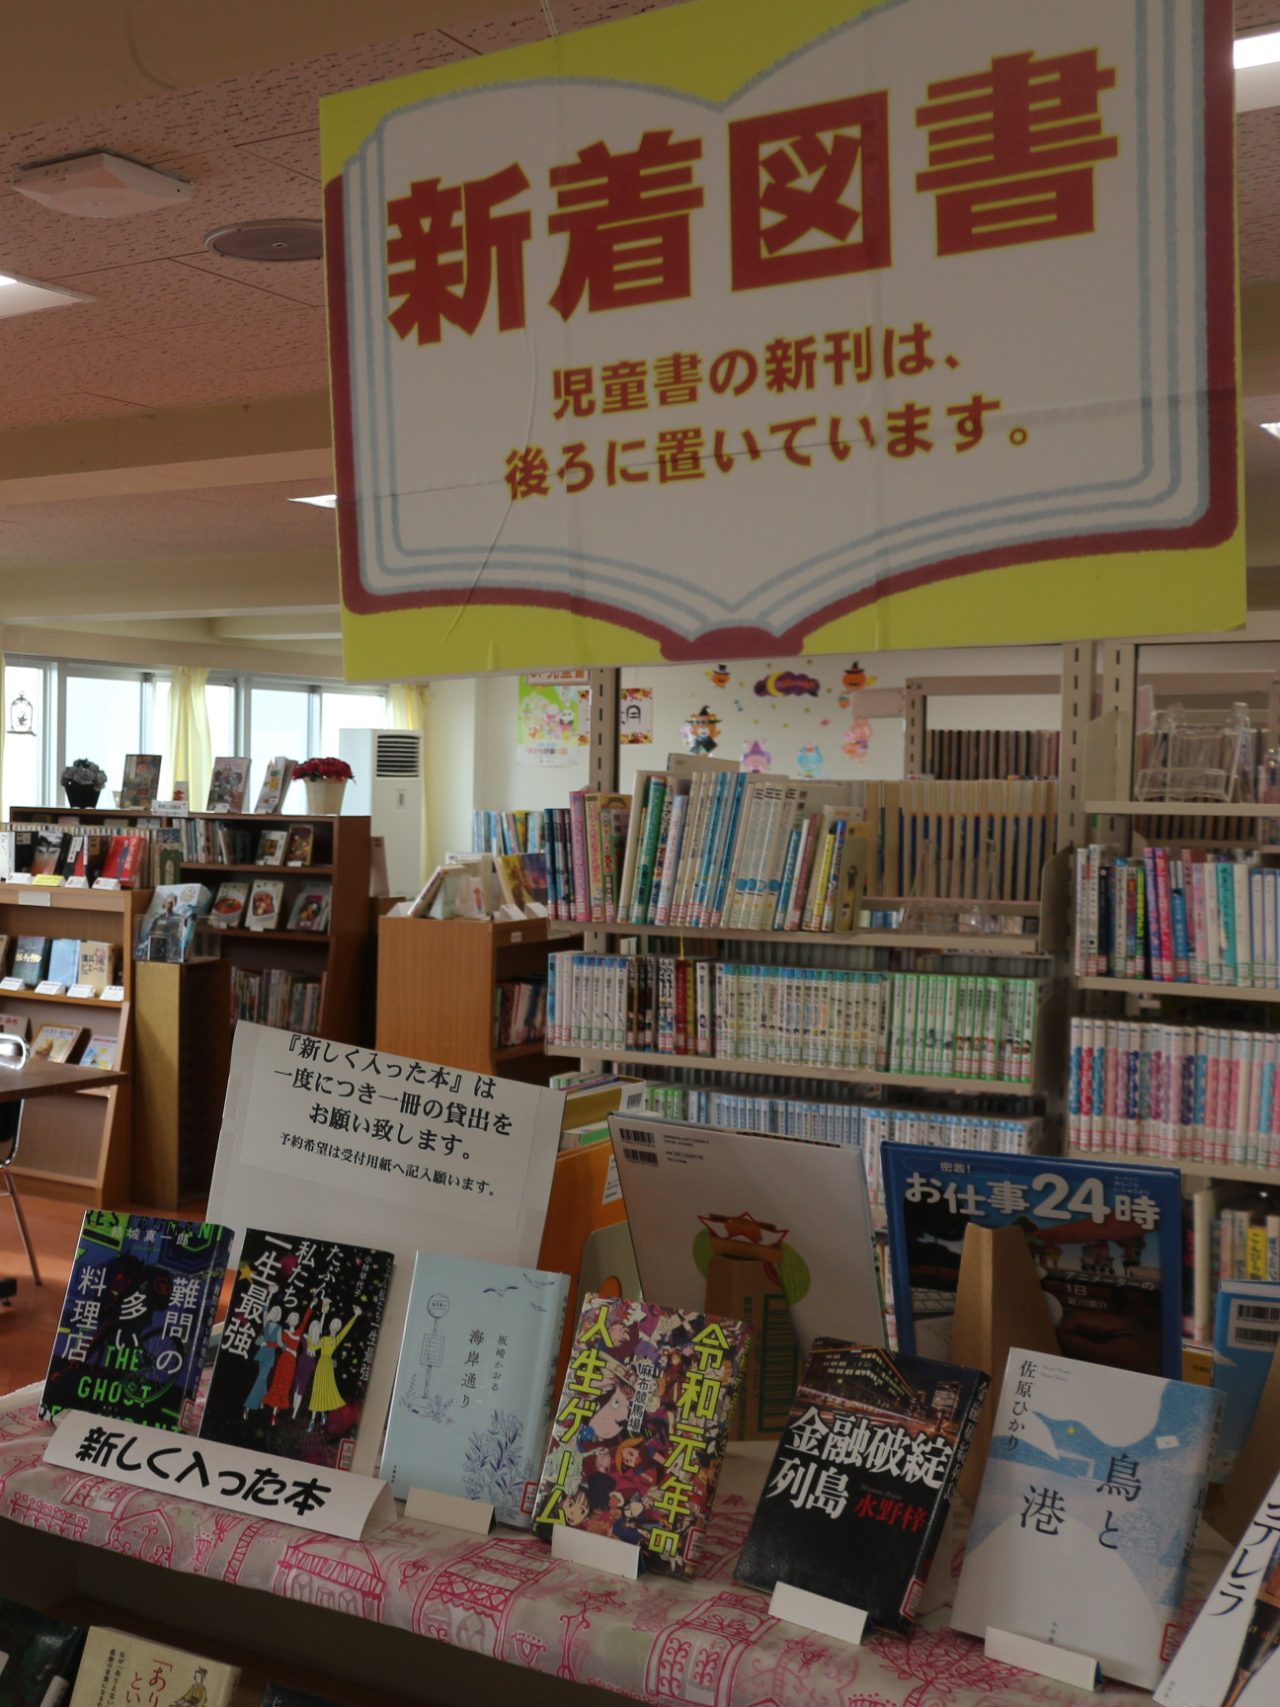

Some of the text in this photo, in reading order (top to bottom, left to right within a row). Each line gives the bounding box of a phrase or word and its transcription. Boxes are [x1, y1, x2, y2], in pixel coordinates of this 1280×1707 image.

[386, 48, 1118, 347] 新着図書
[551, 322, 960, 424] 児童書の新刊は、
[505, 394, 1029, 501] 後ろに置いています。
[274, 1068, 513, 1136] 一度につき一冊の貸出を
[289, 1034, 495, 1099] 『新しく入った本』は
[280, 1132, 495, 1196] 予約希望は受付用紙へ記入願います。
[309, 1103, 471, 1160] お願い致します。
[905, 1172, 1161, 1232] お仕事24時
[221, 1235, 292, 1360] 一生最強
[283, 1241, 317, 1308] 私たち
[318, 1246, 344, 1300] たぶん
[61, 1265, 107, 1363] 料理店
[115, 1291, 148, 1348] 多い
[155, 1277, 200, 1374] 難問の
[77, 1376, 151, 1408] GHOST
[104, 1344, 144, 1372] THE
[461, 1329, 485, 1408] 海岸通り
[537, 1305, 613, 1527] 人生ゲーム
[649, 1322, 729, 1557] 令和元年の
[1008, 1360, 1037, 1451] 佐原ひかり
[75, 1426, 332, 1516] 新しく入った本
[785, 1406, 953, 1489] 金融破綻
[766, 1457, 849, 1519] 列島
[1021, 1485, 1065, 1537] 港
[1096, 1453, 1143, 1550] 鳥と
